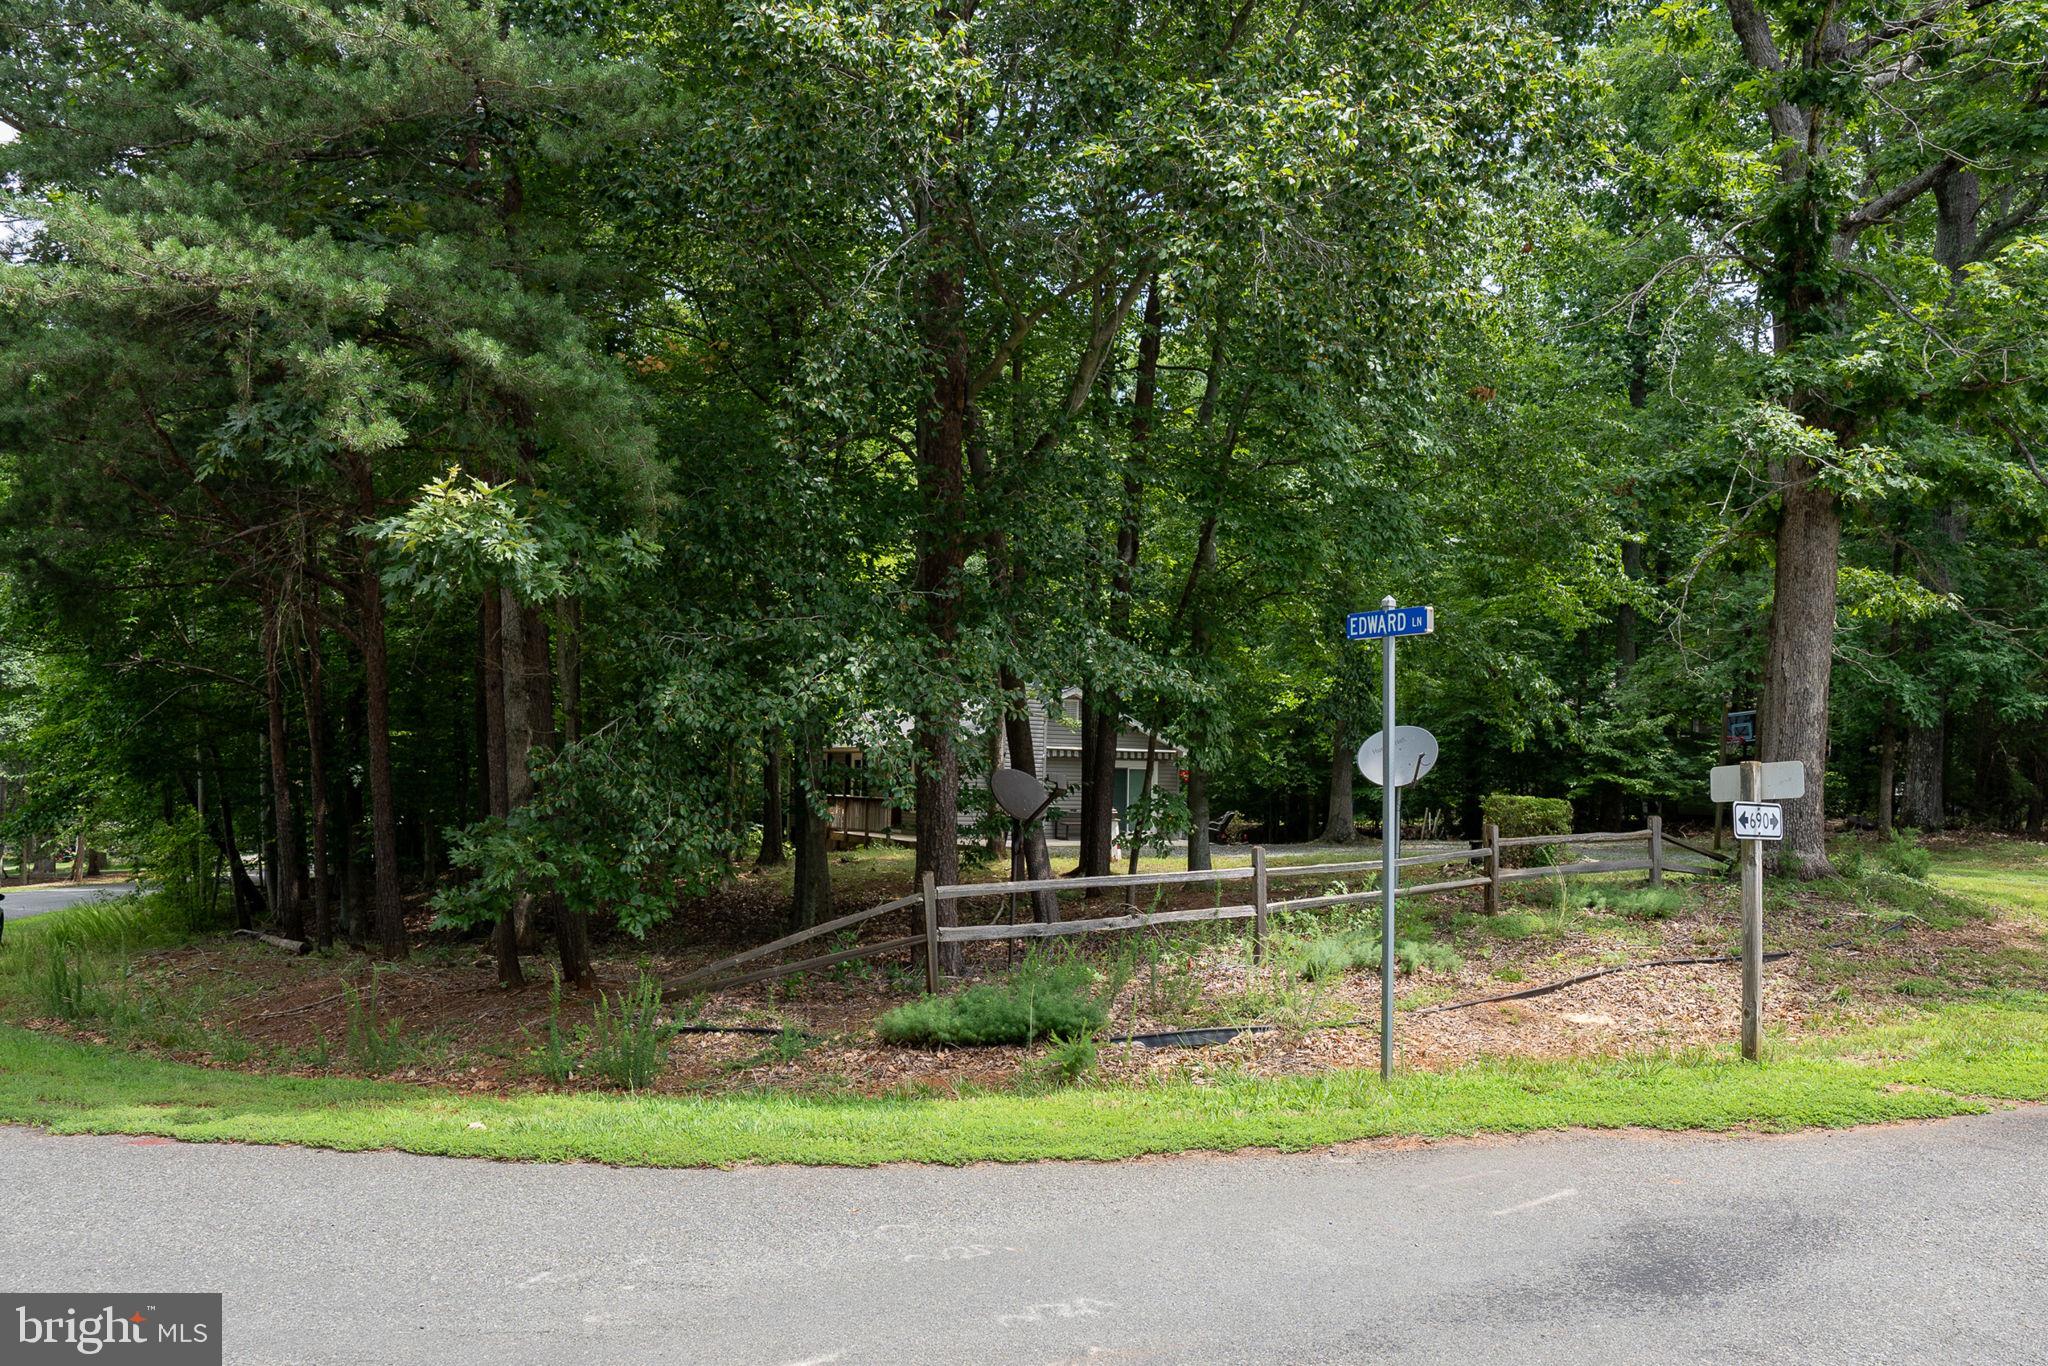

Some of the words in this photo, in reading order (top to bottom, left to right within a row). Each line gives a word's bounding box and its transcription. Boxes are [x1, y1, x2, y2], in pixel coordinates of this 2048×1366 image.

[1350, 612, 1407, 636] EDWARD
[1411, 616, 1422, 628] LN
[1749, 811, 1770, 830] 690
